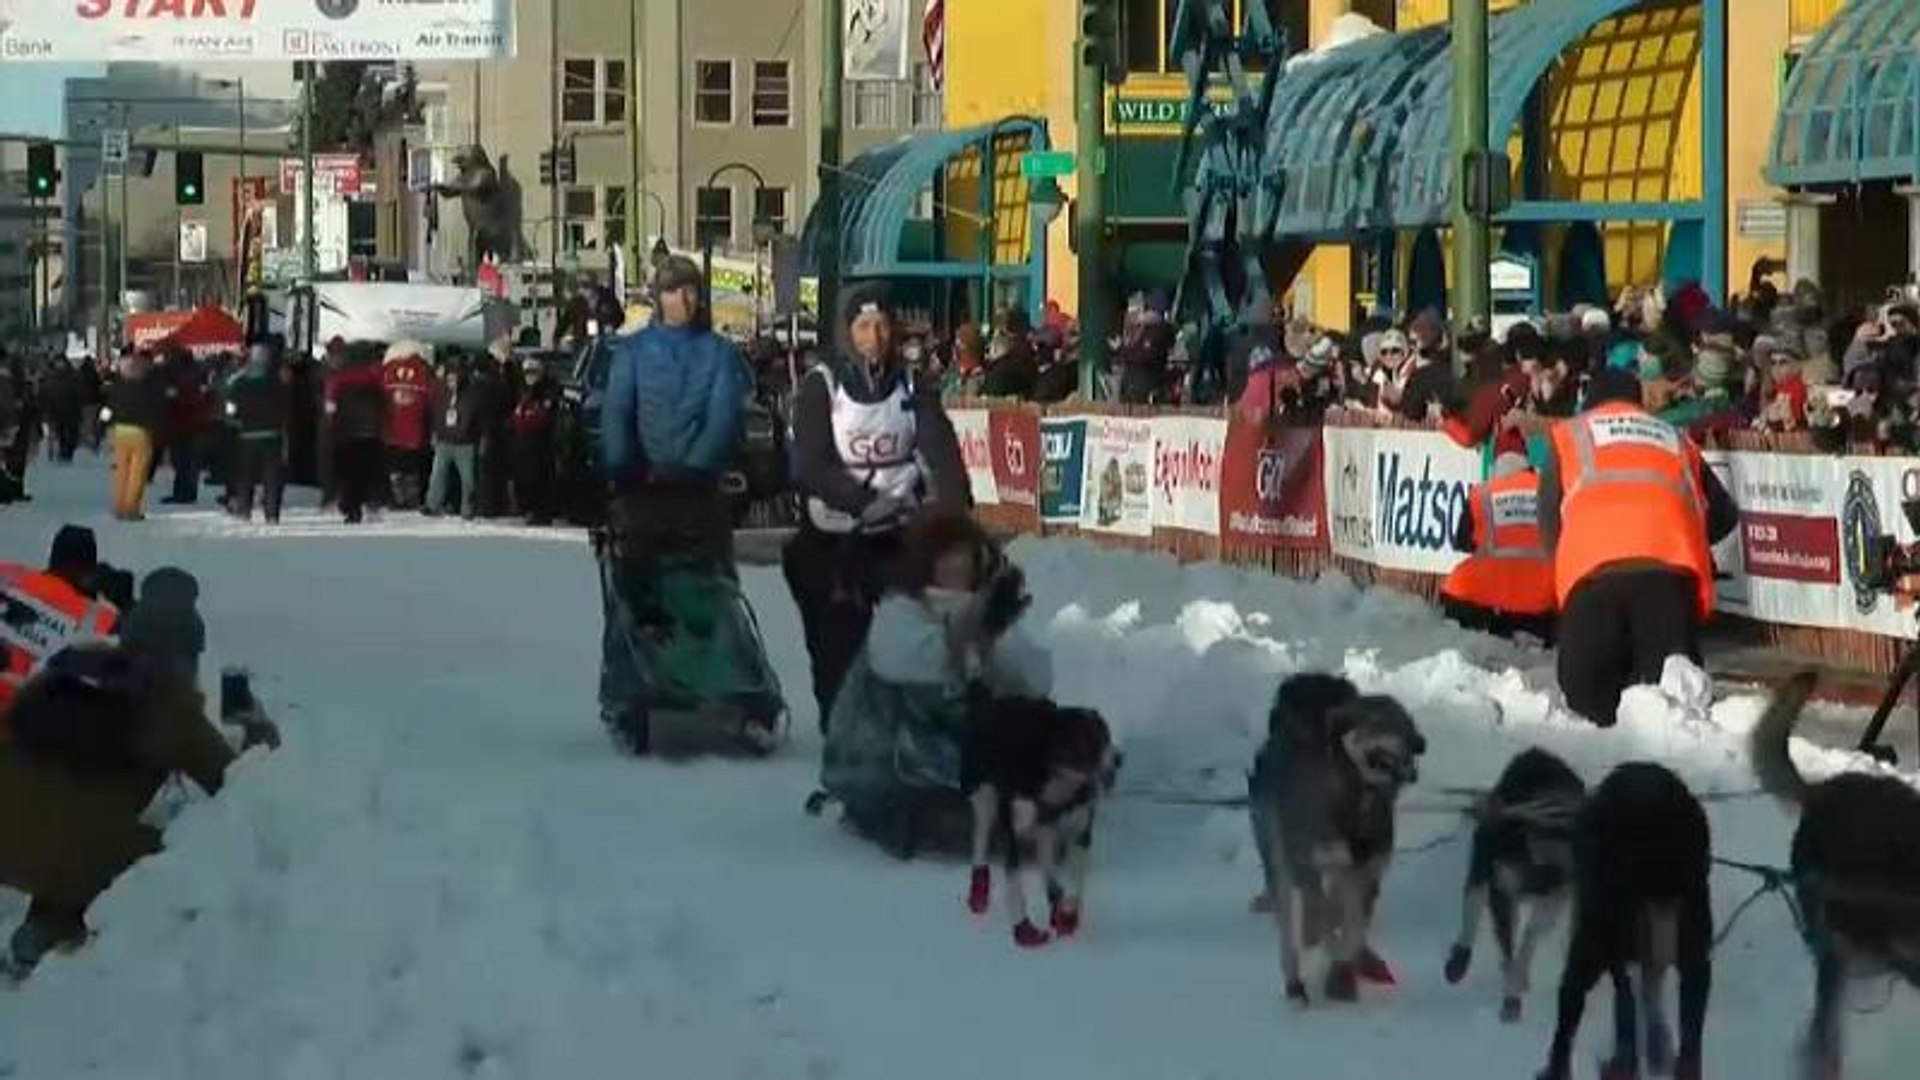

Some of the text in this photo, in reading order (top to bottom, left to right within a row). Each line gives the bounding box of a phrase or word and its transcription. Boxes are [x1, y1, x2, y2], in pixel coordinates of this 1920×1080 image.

[5, 38, 52, 56] Bank
[416, 32, 504, 46] Air Transit
[1118, 101, 1175, 120] WILD
[1377, 451, 1472, 553] Matso
